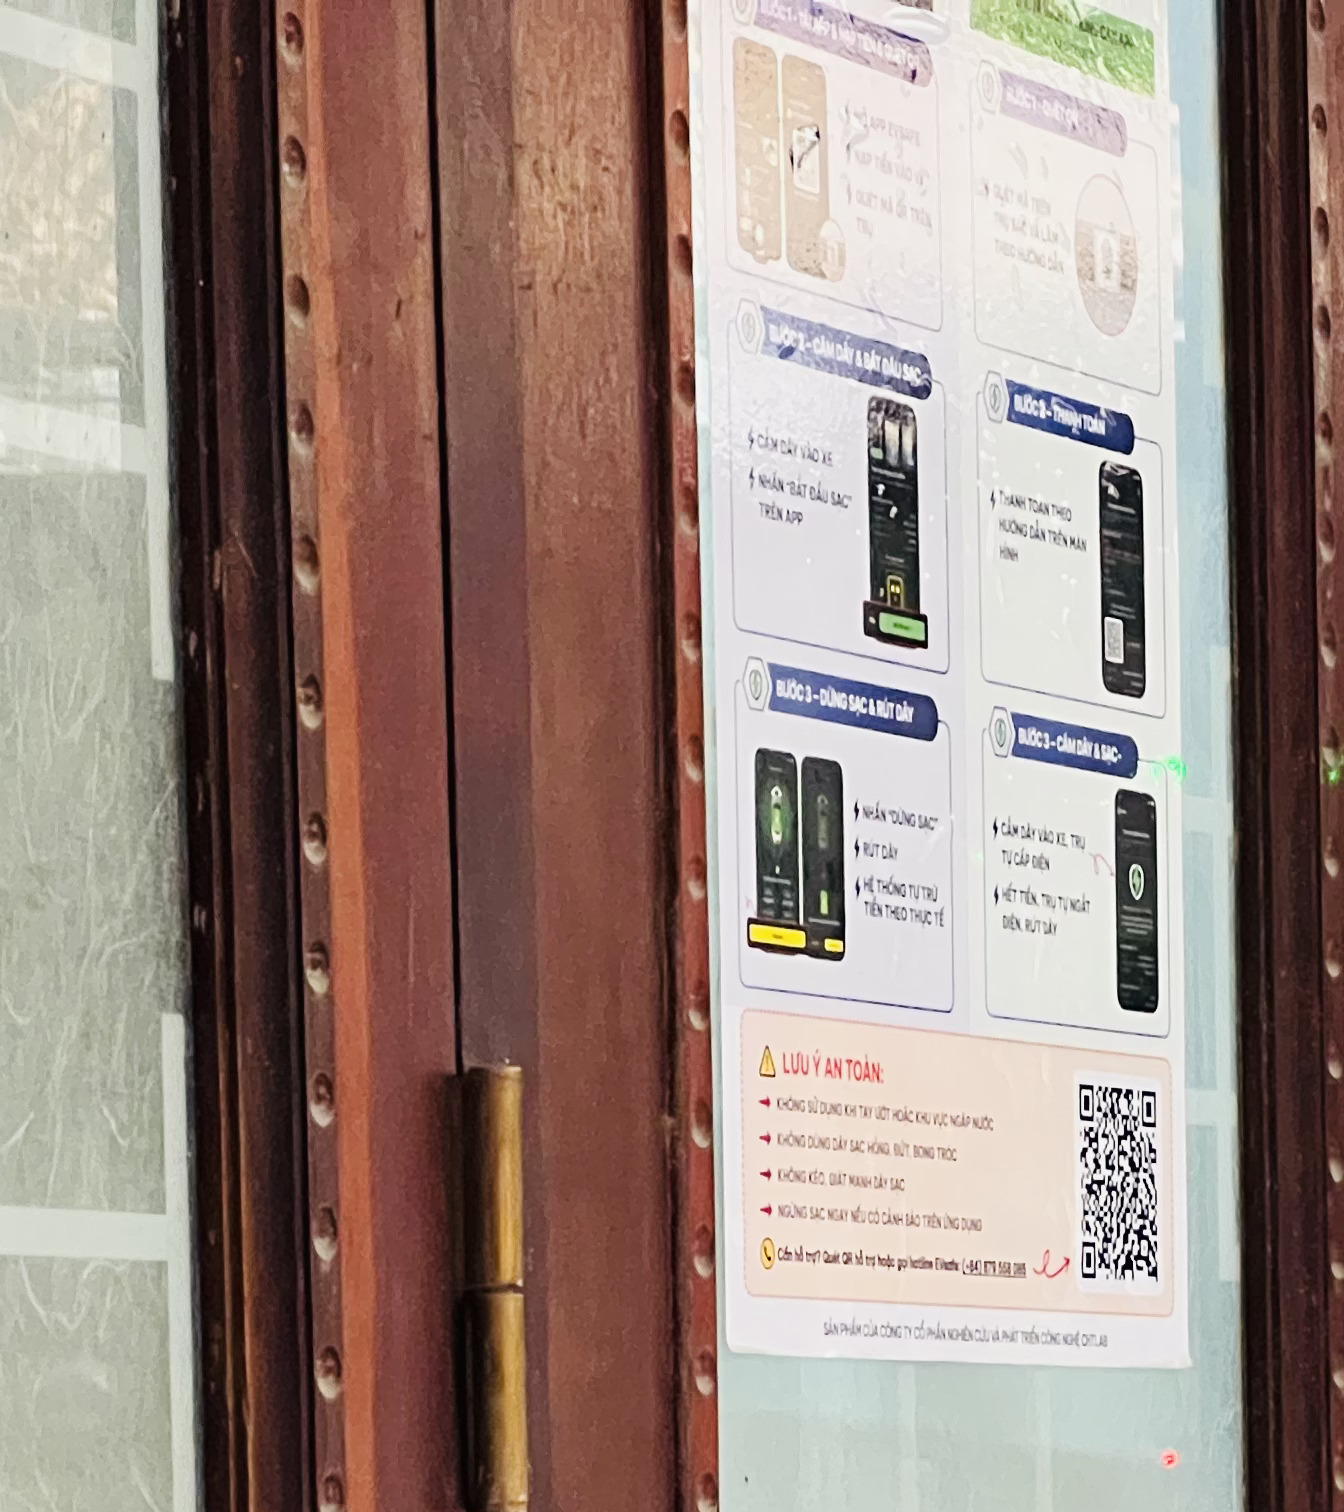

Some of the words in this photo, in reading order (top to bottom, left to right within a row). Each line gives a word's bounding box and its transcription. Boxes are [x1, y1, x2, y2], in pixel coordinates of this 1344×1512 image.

[855, 348, 863, 368] &
[785, 508, 803, 527] APP
[1051, 504, 1071, 522] THEO
[776, 676, 803, 702] BƯỚC
[805, 685, 812, 703] 3
[868, 698, 876, 716] &
[877, 696, 893, 719] RÚT
[895, 700, 914, 724] DÂY
[1017, 724, 1041, 747] BƯỚC
[1042, 731, 1049, 749] 3
[1094, 742, 1100, 759] &
[863, 837, 880, 858] RÚT
[884, 904, 907, 921] THEO
[782, 1050, 809, 1076] LƯU
[812, 1049, 821, 1077] Ý
[824, 1056, 842, 1079] AN
[845, 1052, 884, 1084] TOÀN:
[777, 1093, 805, 1111] KHÔNG
[844, 1103, 857, 1117] KHI
[858, 1105, 872, 1118] TAY
[915, 1111, 931, 1124] KHU
[777, 1128, 805, 1147] KHÔNG
[832, 1134, 847, 1151] DÂY
[777, 1165, 806, 1183] KHÔNG
[873, 1172, 888, 1190] DÂY
[827, 1207, 848, 1222] NGAY
[867, 1207, 880, 1224] CÓ
[922, 1212, 942, 1229] TRÊN
